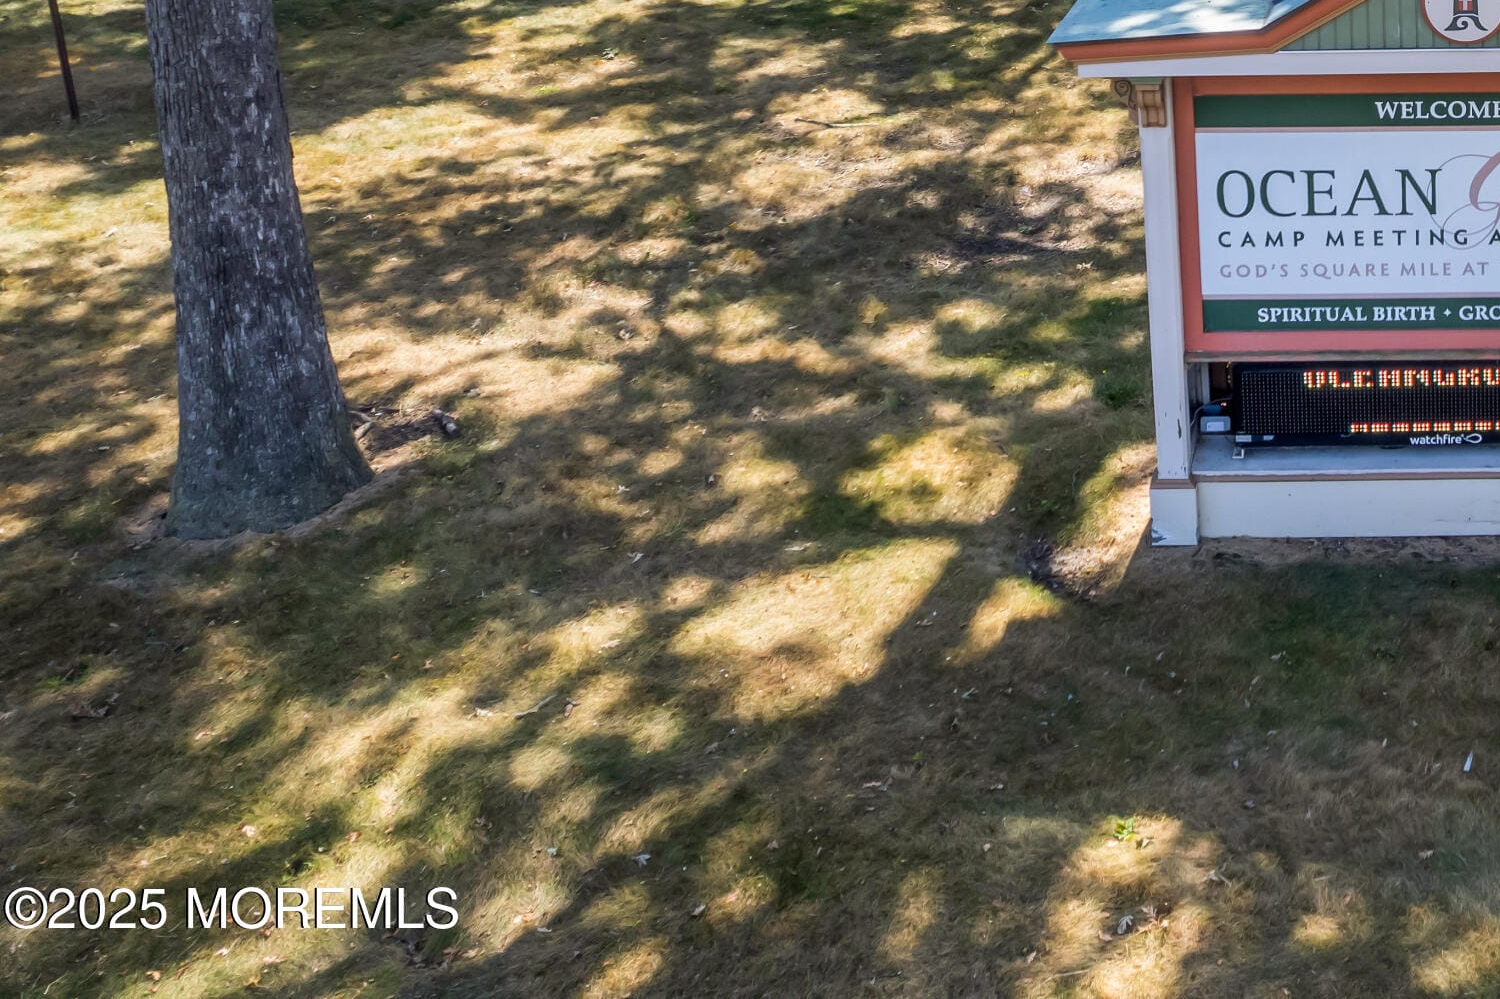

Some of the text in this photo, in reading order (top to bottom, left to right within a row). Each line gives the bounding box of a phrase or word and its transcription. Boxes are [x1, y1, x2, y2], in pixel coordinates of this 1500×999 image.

[1216, 168, 1443, 218] OCEAN
[1217, 230, 1306, 248] CAMP
[1325, 229, 1469, 247] MEETING
[1219, 263, 1289, 279] GOD'S
[1300, 262, 1390, 280] SQUARE
[1400, 262, 1452, 277] MILE
[1462, 261, 1489, 276] AT
[1257, 306, 1368, 323] SPIRITUAL
[1372, 305, 1437, 321] BIRTH
[1409, 433, 1463, 445] watchfire
